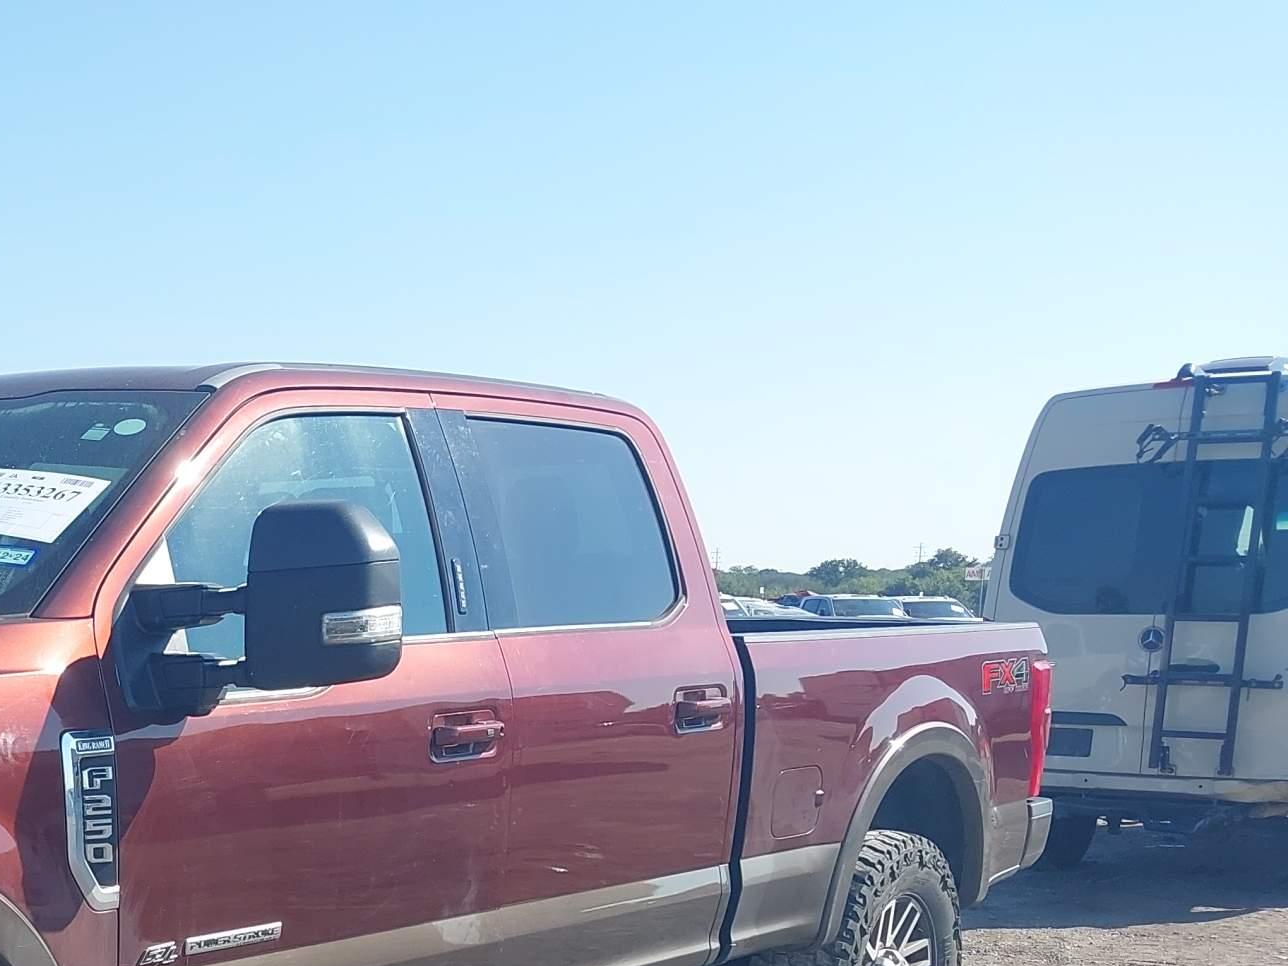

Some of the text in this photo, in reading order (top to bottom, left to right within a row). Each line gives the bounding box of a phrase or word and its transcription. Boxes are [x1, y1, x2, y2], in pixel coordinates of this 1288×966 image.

[982, 656, 1029, 695] FX4
[82, 766, 113, 863] F250
[189, 936, 231, 951] POWER
[232, 926, 281, 944] STROKE
